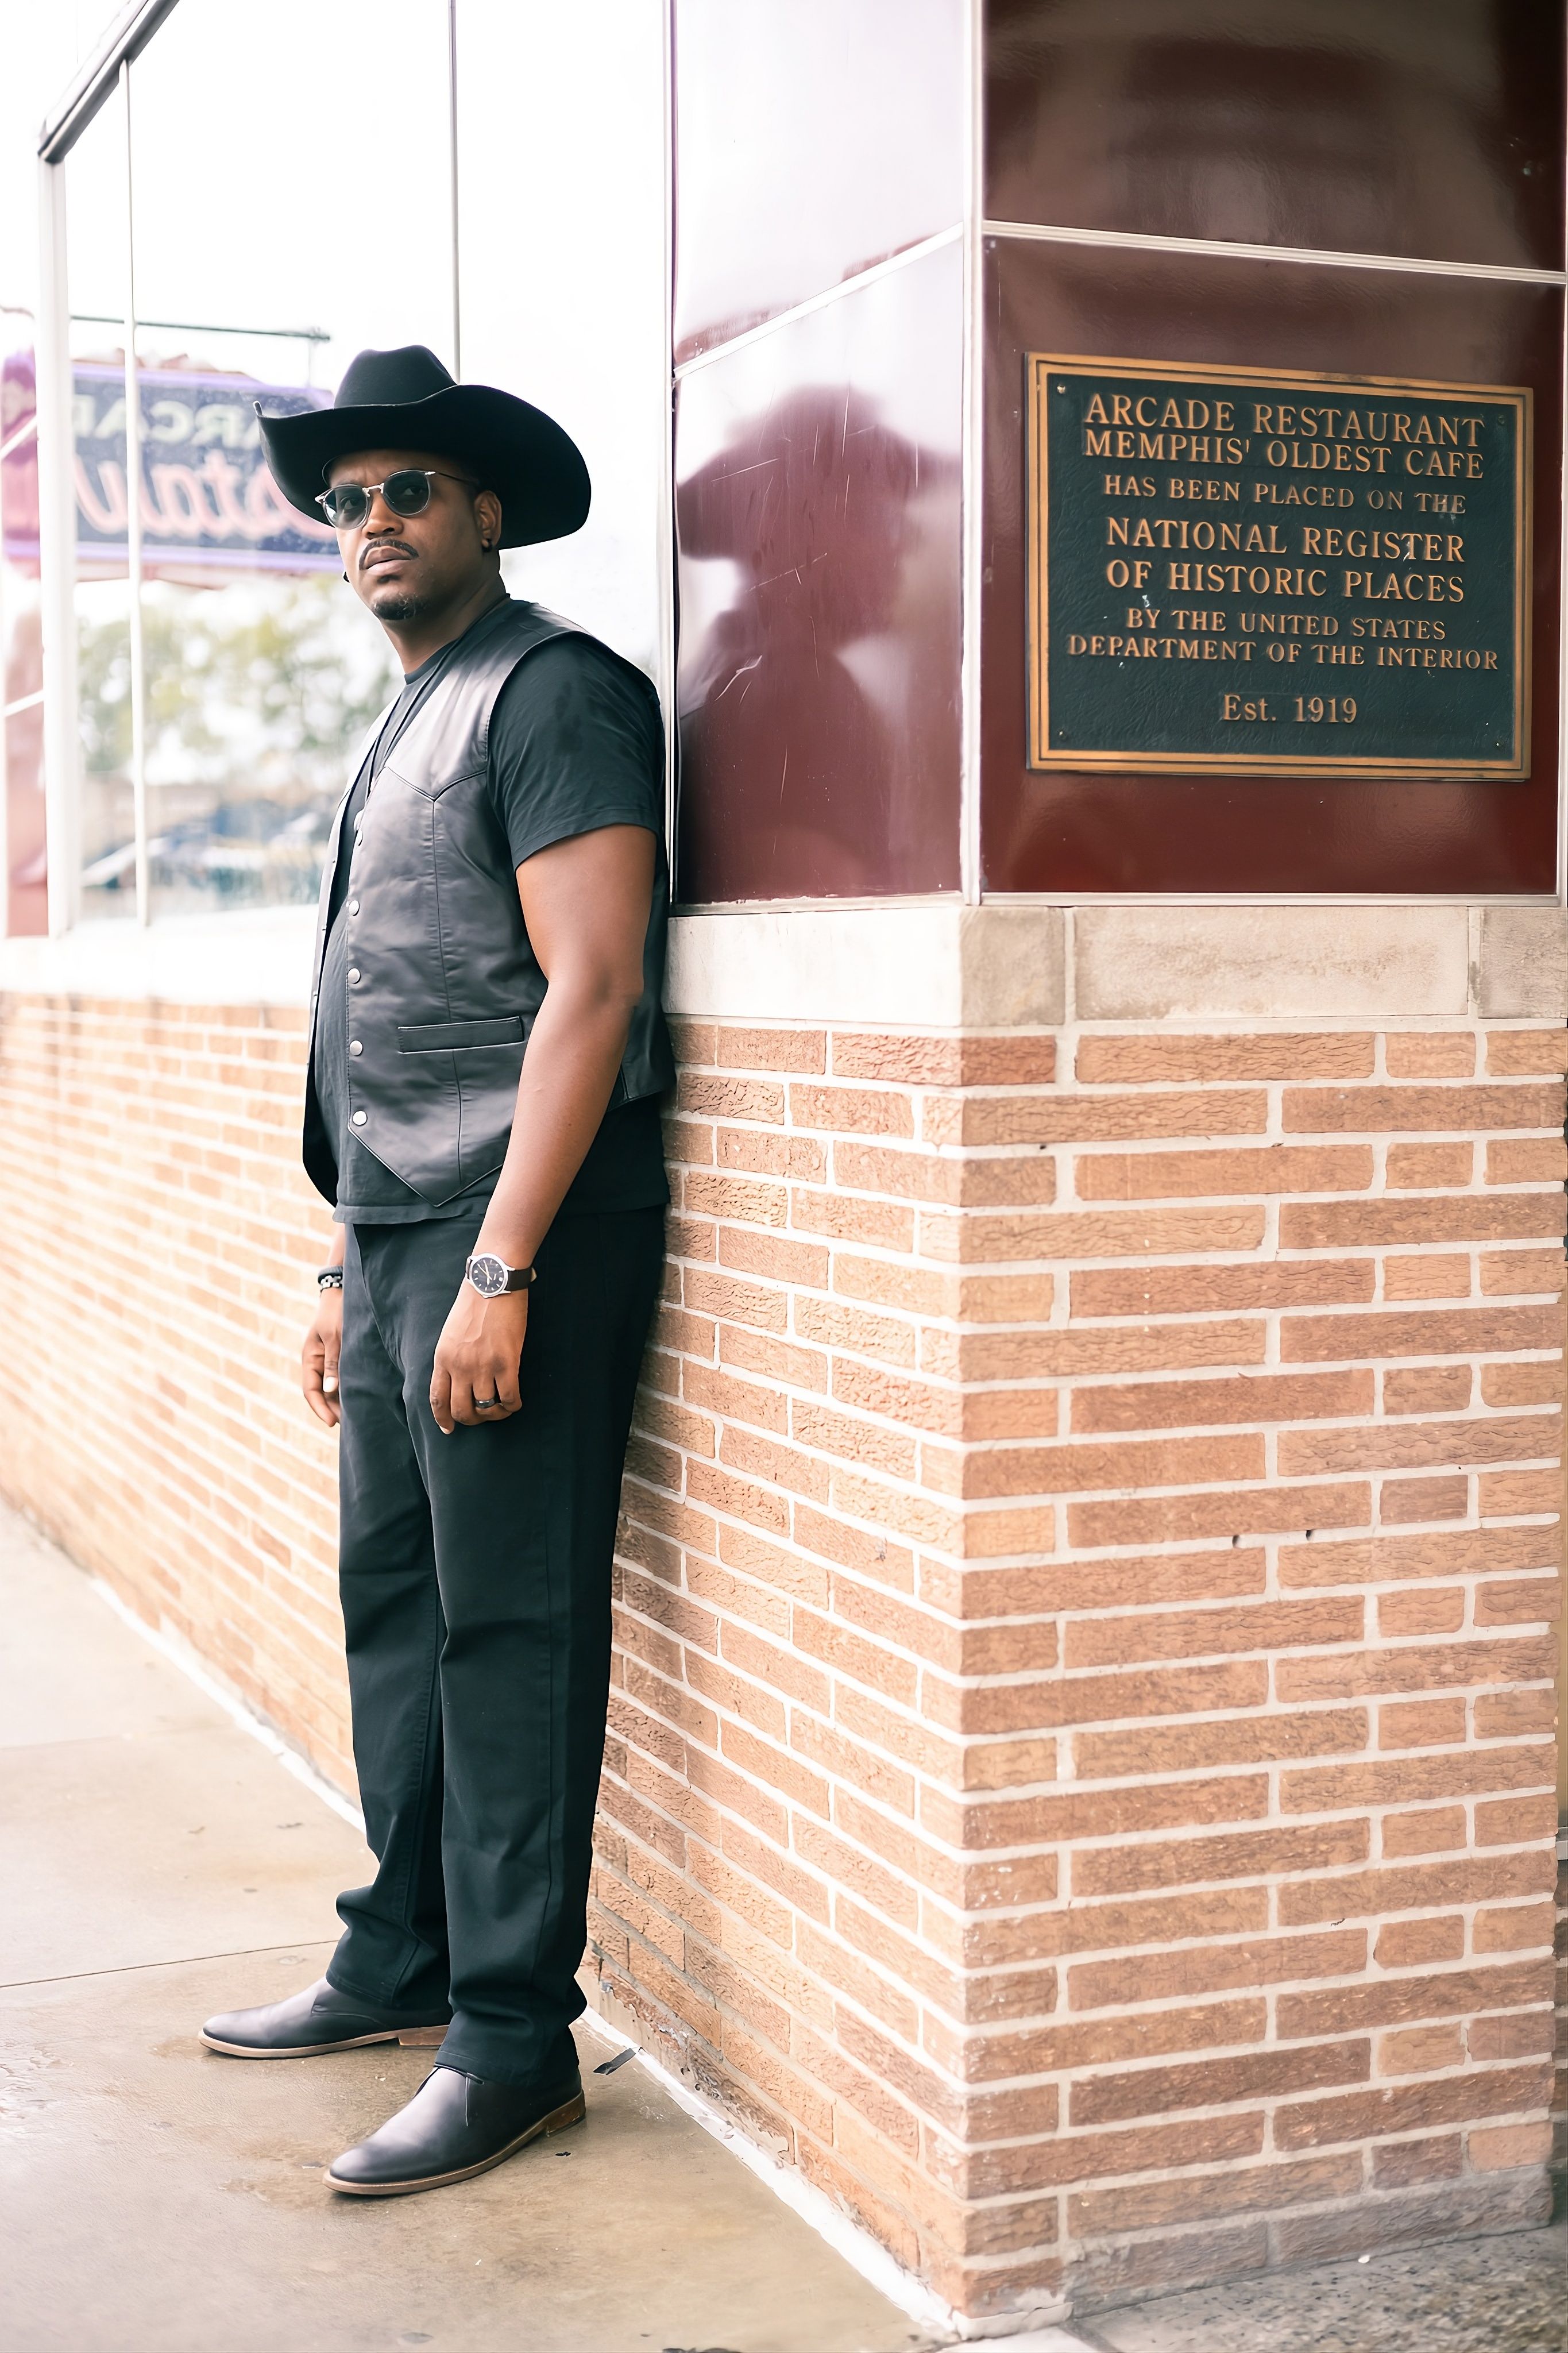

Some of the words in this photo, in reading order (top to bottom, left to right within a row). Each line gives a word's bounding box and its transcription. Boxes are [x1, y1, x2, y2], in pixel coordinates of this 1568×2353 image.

[1084, 394, 1234, 430] ARCADE
[1254, 404, 1485, 446] RESTAURANT
[1086, 429, 1250, 463] MEMPHIS'
[1268, 441, 1392, 472] OLDEST
[1407, 450, 1484, 477] CAFE
[1104, 476, 1156, 496] HAS
[1171, 481, 1240, 500] BEEN
[1256, 485, 1354, 506] PLACED
[1369, 491, 1403, 509] ON
[1416, 493, 1466, 513] THE
[1107, 518, 1287, 553] NATIONAL
[1303, 528, 1465, 562] REGISTER
[1106, 560, 1152, 588] OF
[1170, 564, 1327, 596] HISTORIC
[1345, 572, 1465, 601] PLACES
[1127, 609, 1160, 629] BY
[1173, 611, 1226, 630] THE
[1239, 613, 1338, 635] UNITED
[1353, 618, 1446, 639] STATES
[1067, 635, 1256, 661] DEPARTMENT
[1268, 643, 1301, 662] OF
[1311, 646, 1364, 664] THE
[1378, 647, 1499, 669] INTERIOR
[1223, 695, 1276, 720] Est.
[1295, 697, 1357, 722] 1919
